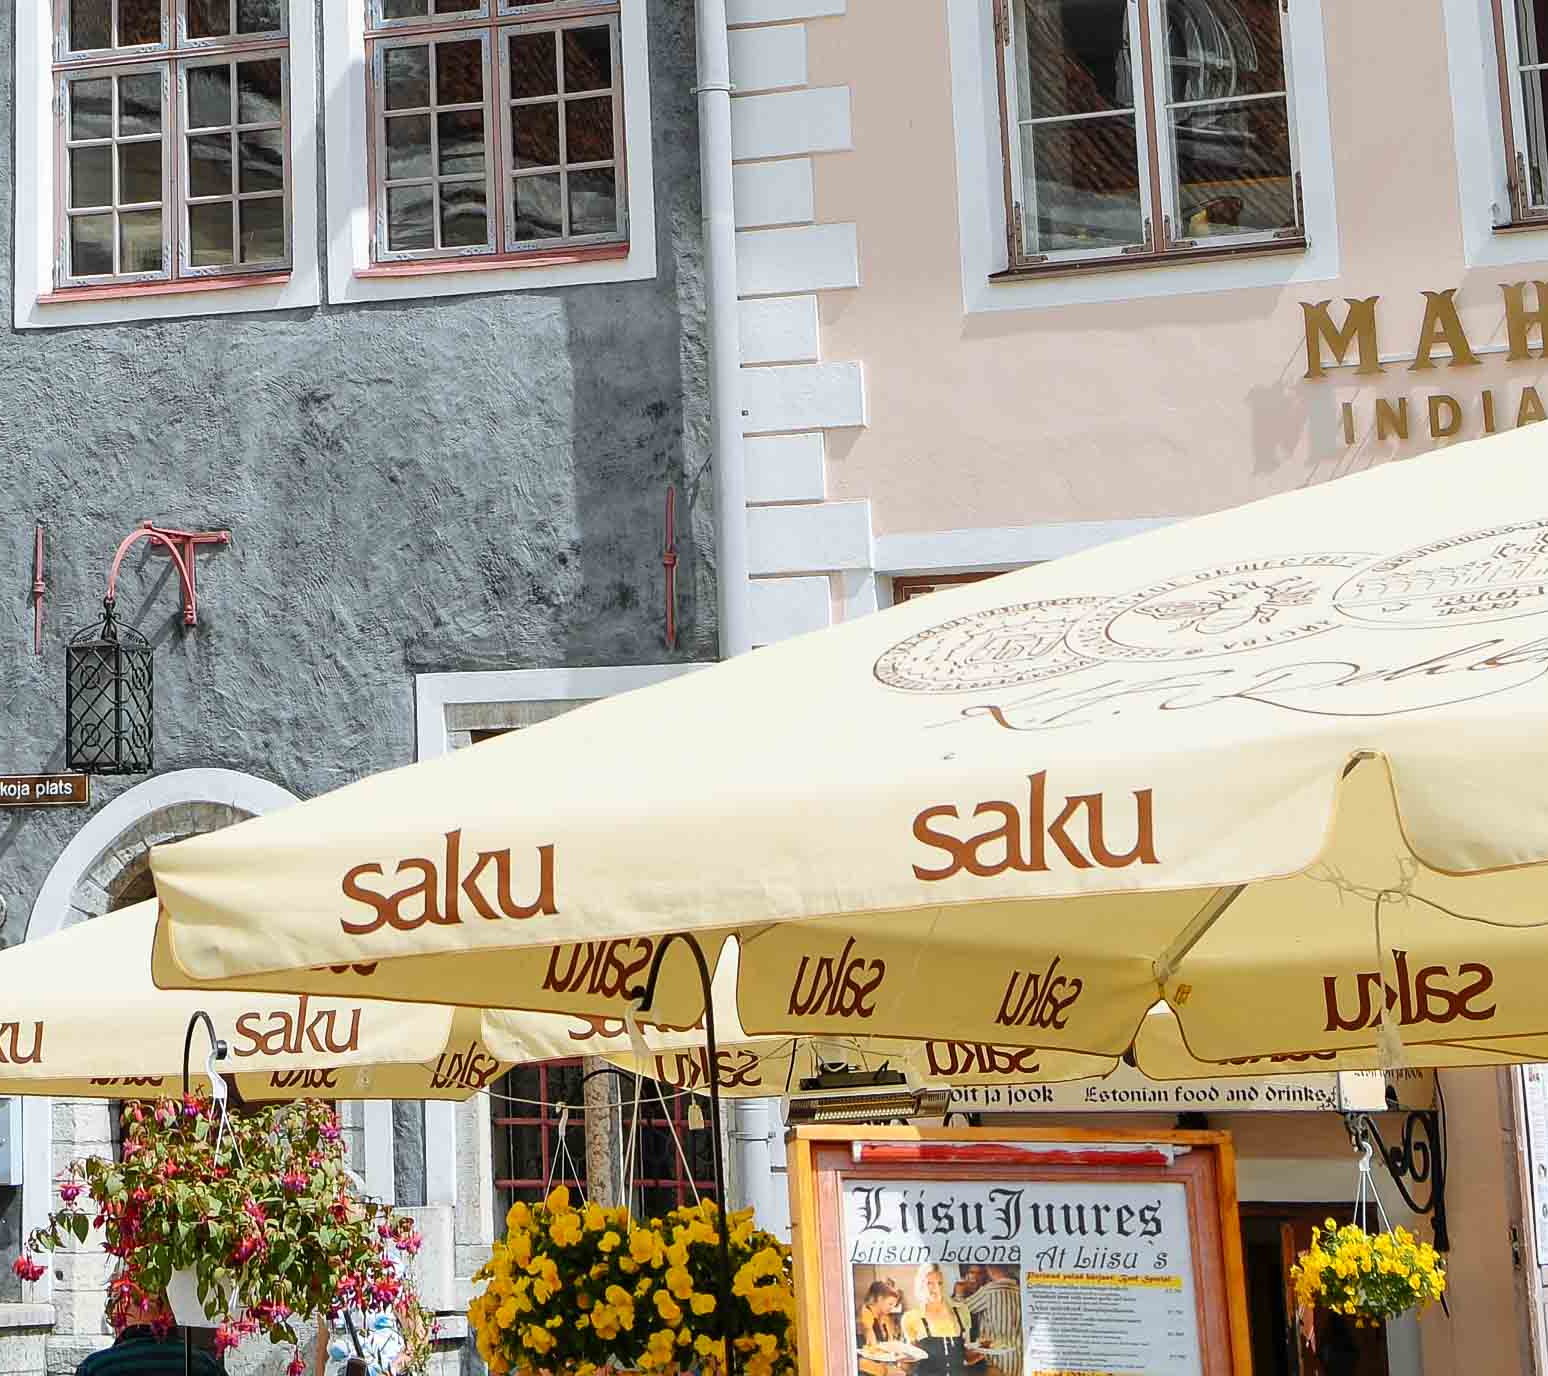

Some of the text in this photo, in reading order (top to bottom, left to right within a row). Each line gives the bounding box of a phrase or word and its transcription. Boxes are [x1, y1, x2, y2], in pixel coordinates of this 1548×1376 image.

[1343, 386, 1548, 445] INDIA
[36, 779, 73, 797] plats
[912, 770, 1160, 881] saku
[341, 829, 559, 935] saku
[234, 992, 361, 1057] saku
[951, 1085, 1055, 1107] oit ja jook
[1084, 1085, 1327, 1104] Estonian food and drinks
[853, 1186, 1164, 1241] Liisu Juures
[850, 1239, 1022, 1264] Liisun Luona
[1036, 1250, 1065, 1273] At
